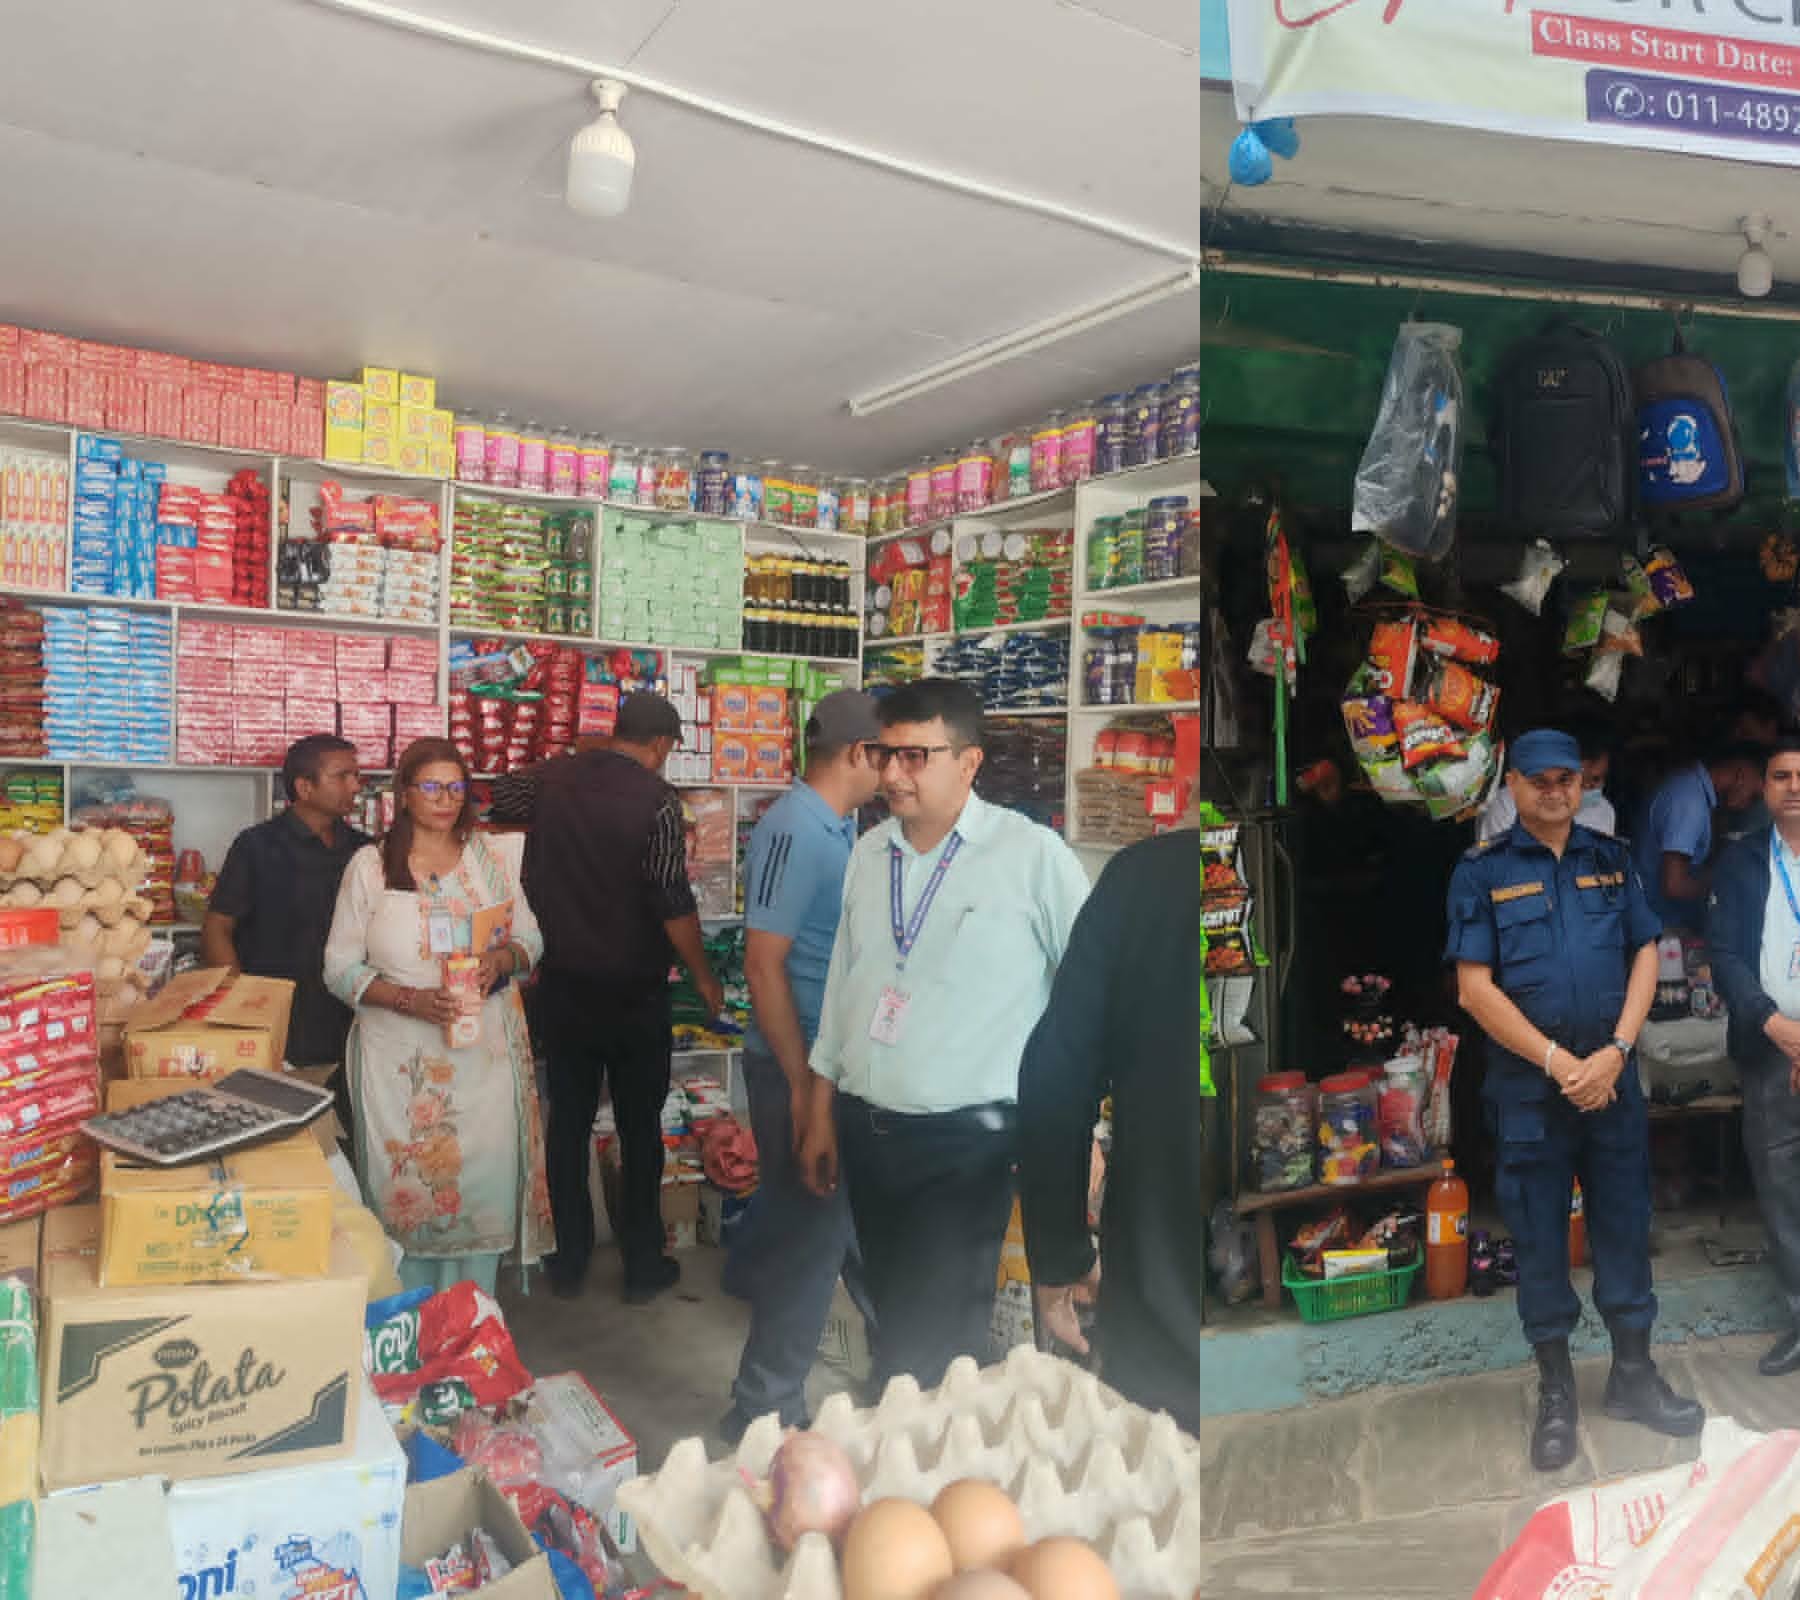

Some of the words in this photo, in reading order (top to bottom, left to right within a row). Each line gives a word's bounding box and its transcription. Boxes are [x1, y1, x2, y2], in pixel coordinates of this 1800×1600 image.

[1538, 17, 1622, 52] Class
[1631, 28, 1704, 65] Start
[1716, 40, 1793, 76] Date:
[126, 1347, 286, 1429] Potata
